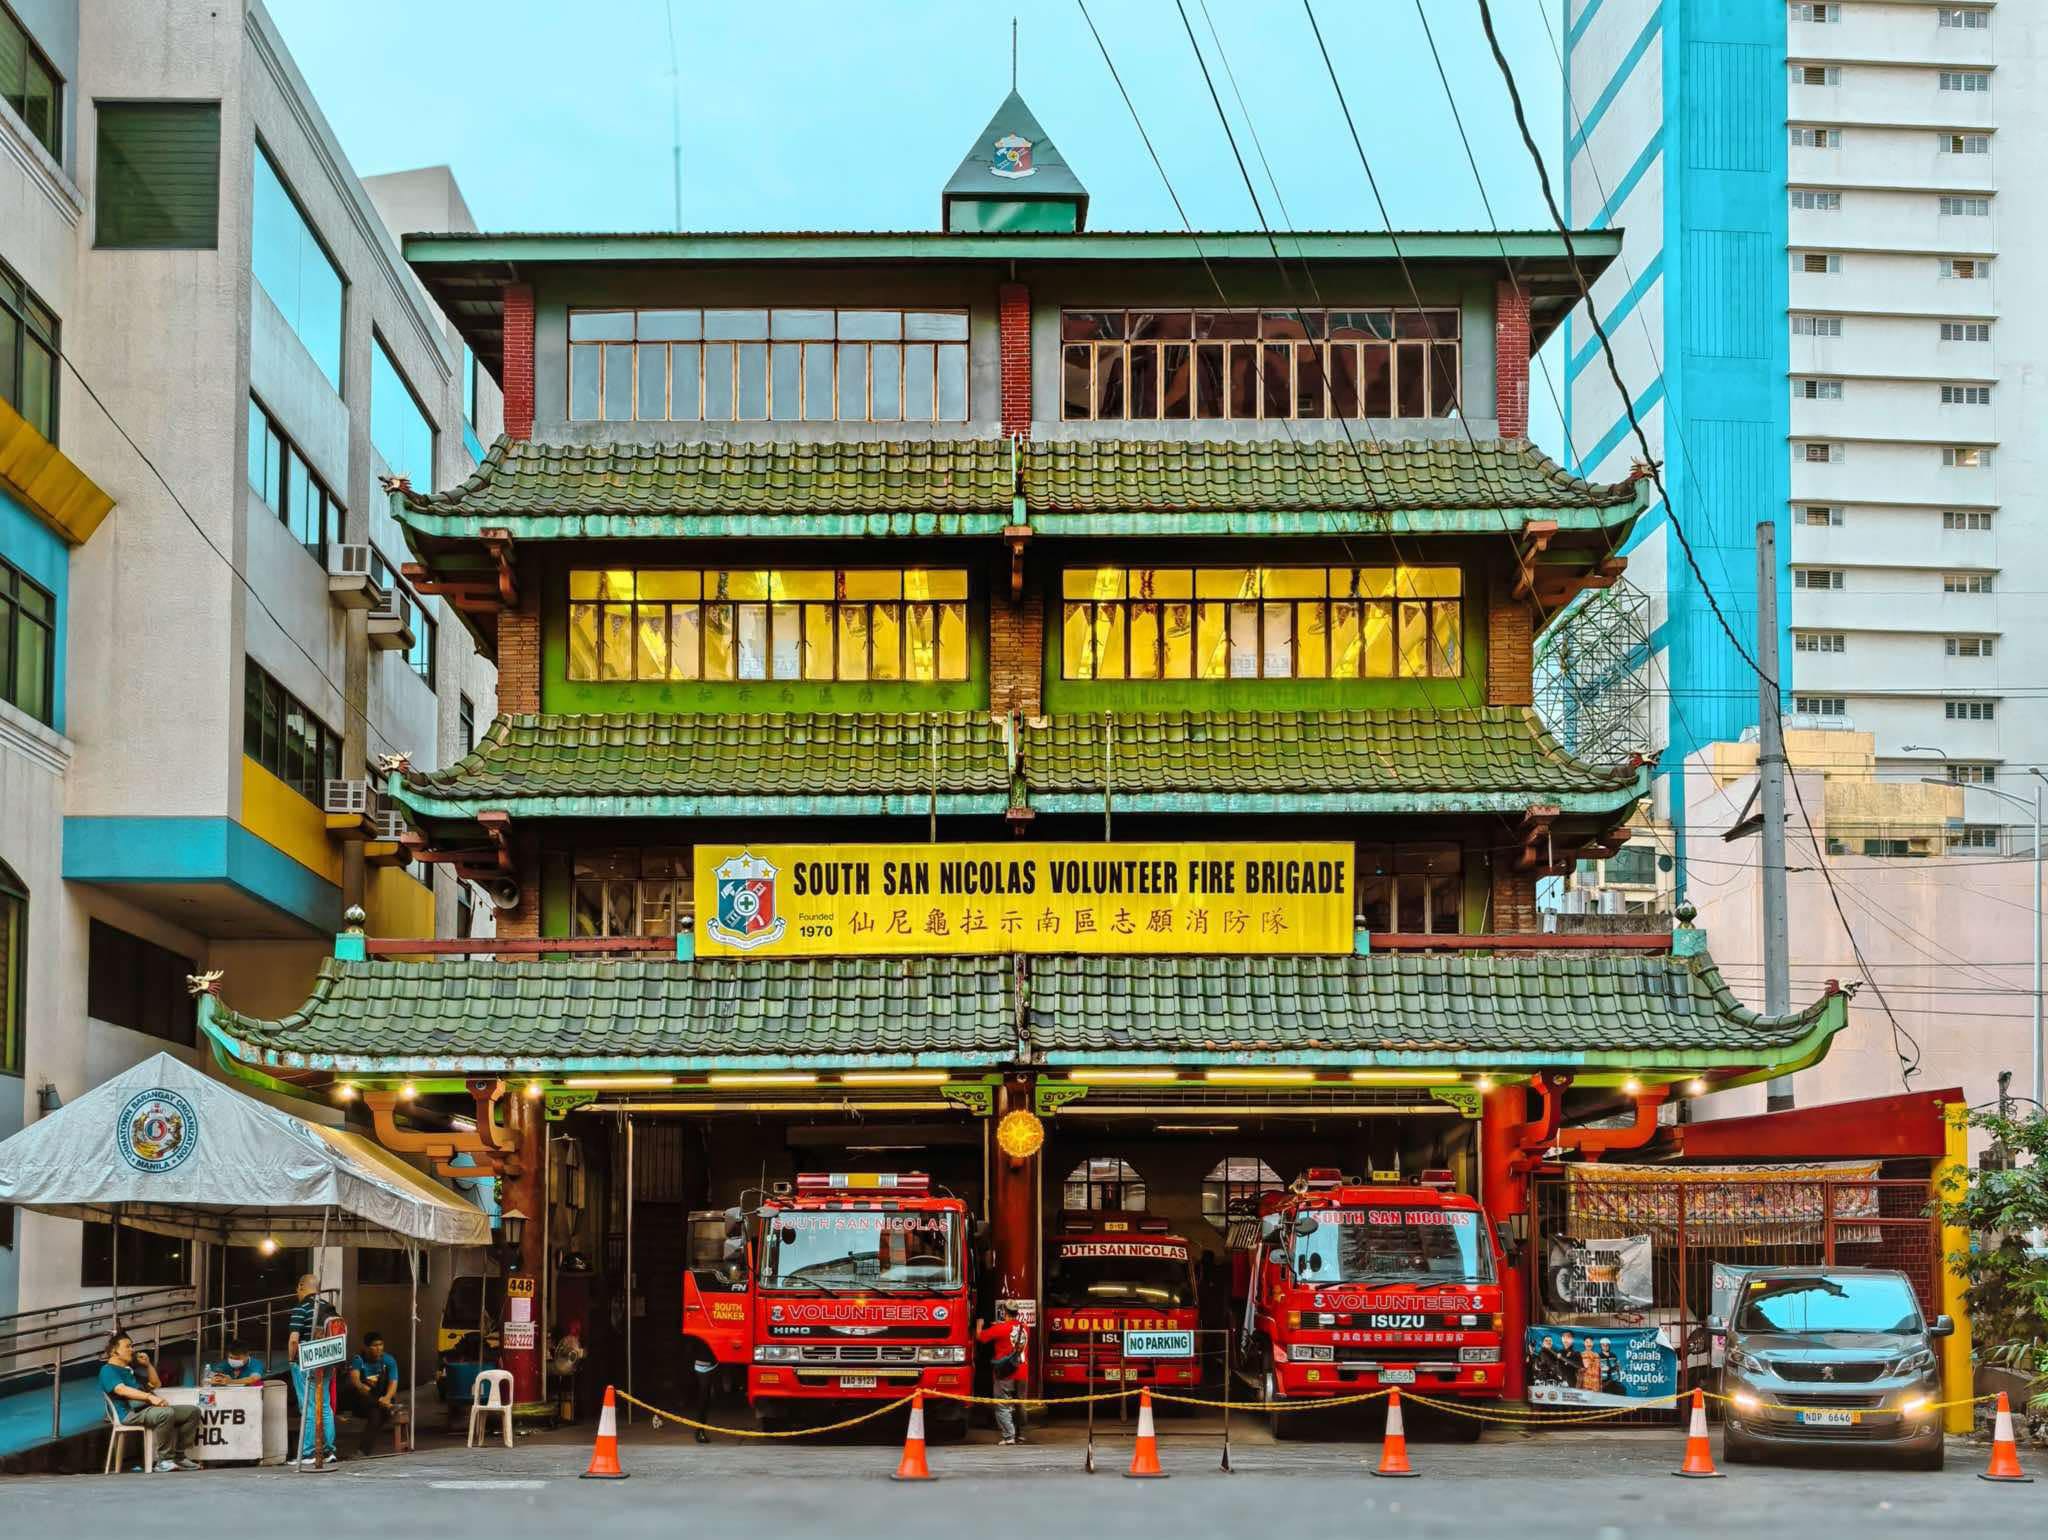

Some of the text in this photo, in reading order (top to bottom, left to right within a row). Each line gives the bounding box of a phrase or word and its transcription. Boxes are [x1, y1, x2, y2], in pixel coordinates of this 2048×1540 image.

[793, 860, 1345, 896] SOUTH SAN NICOLAS VOLUNTEER FIRE BRIGADE
[798, 912, 835, 921] Founded
[799, 925, 833, 937] 1970
[131, 1090, 176, 1109] BARANGAY
[135, 1159, 170, 1170] MANILA
[772, 1217, 950, 1232] SOUTH SAN NICOLAS
[1311, 1210, 1470, 1225] SOUTH SAN NICOLAS
[1060, 1244, 1186, 1259] OUTH SAN NICOLAS
[509, 1279, 533, 1293] 448
[730, 1283, 747, 1292] FN
[1602, 1281, 1616, 1297] KA
[714, 1302, 743, 1312] SOUTH
[1327, 1294, 1471, 1311] VOLUNTEER
[711, 1310, 745, 1321] TANKER
[788, 1304, 929, 1321] VOLUNTEER
[1370, 1314, 1425, 1328] ISUZU
[772, 1326, 811, 1335] HINO
[1129, 1335, 1188, 1350] NO PARKING
[1629, 1338, 1657, 1350] Oplan
[303, 1341, 342, 1362] NO PARKING
[1625, 1350, 1662, 1361] Paalala
[1619, 1371, 1665, 1386] Paputok
[200, 1409, 246, 1426] NVFB
